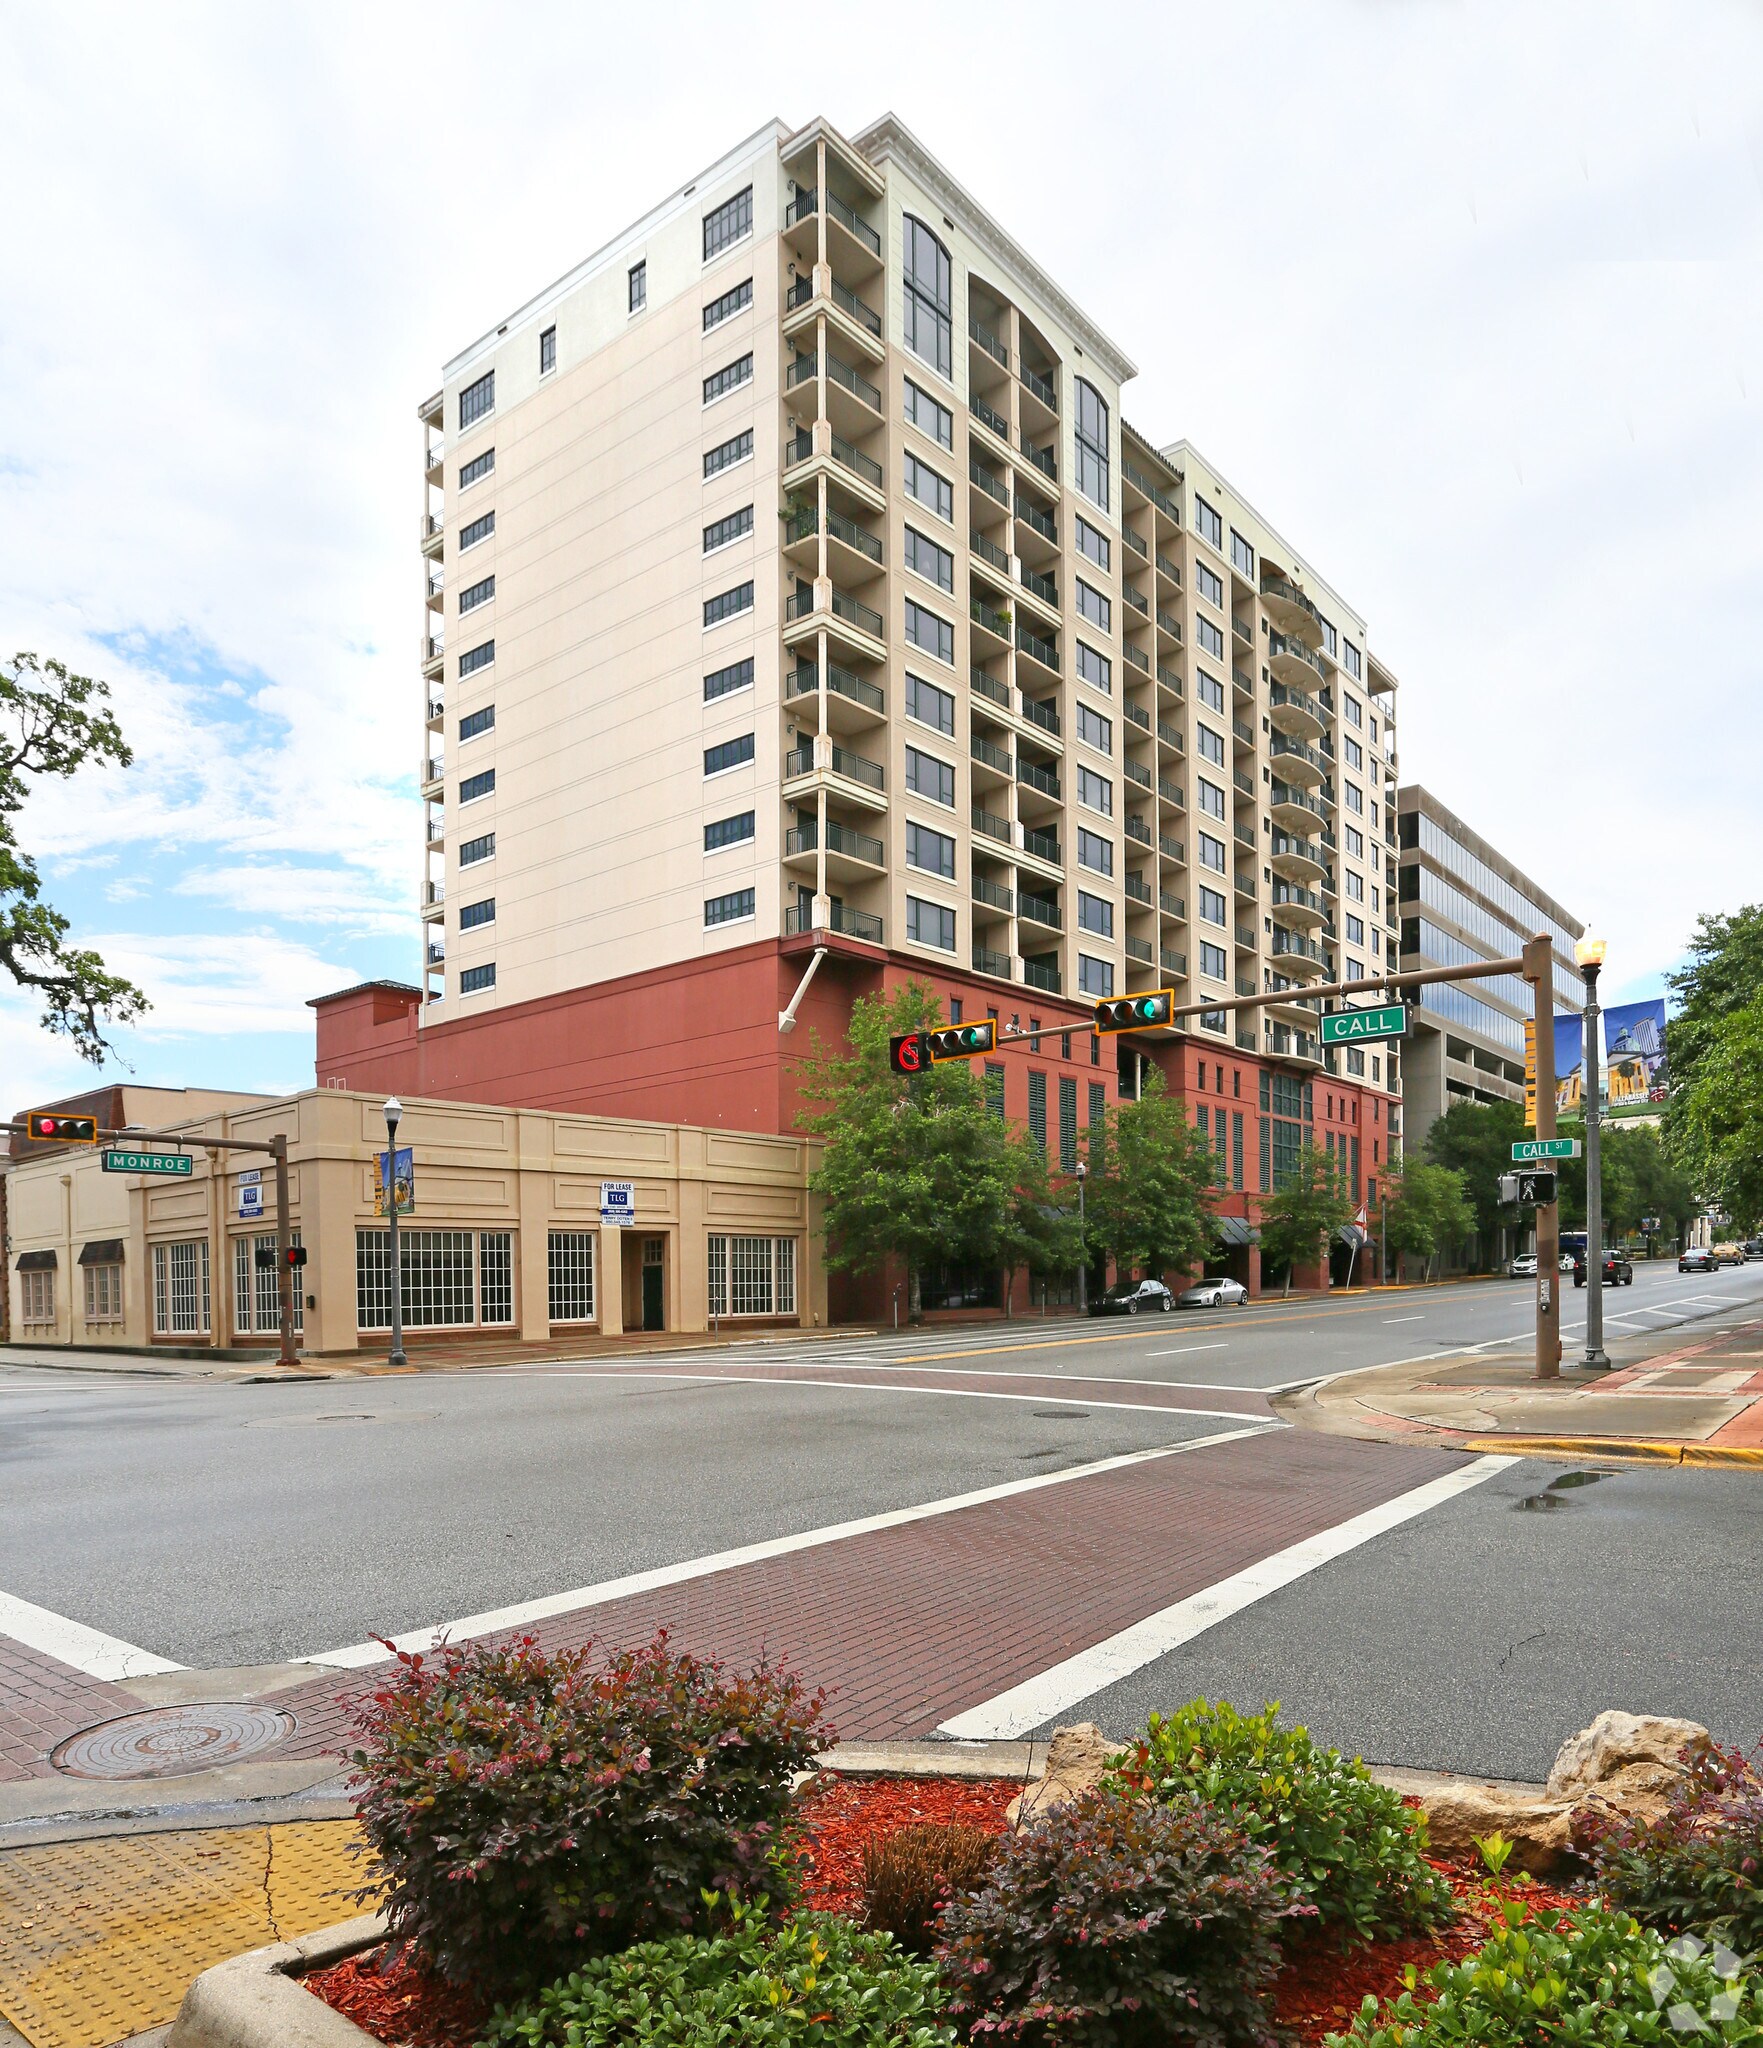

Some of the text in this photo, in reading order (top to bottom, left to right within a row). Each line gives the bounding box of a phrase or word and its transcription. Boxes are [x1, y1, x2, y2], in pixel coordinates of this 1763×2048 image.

[1334, 1014, 1392, 1036] CALL
[1522, 1143, 1553, 1157] CALL
[113, 1156, 186, 1170] MONROE
[248, 1172, 260, 1181] LEASE
[615, 1183, 632, 1191] LEASE
[244, 1191, 256, 1200] TLG
[610, 1194, 625, 1202] TLG
